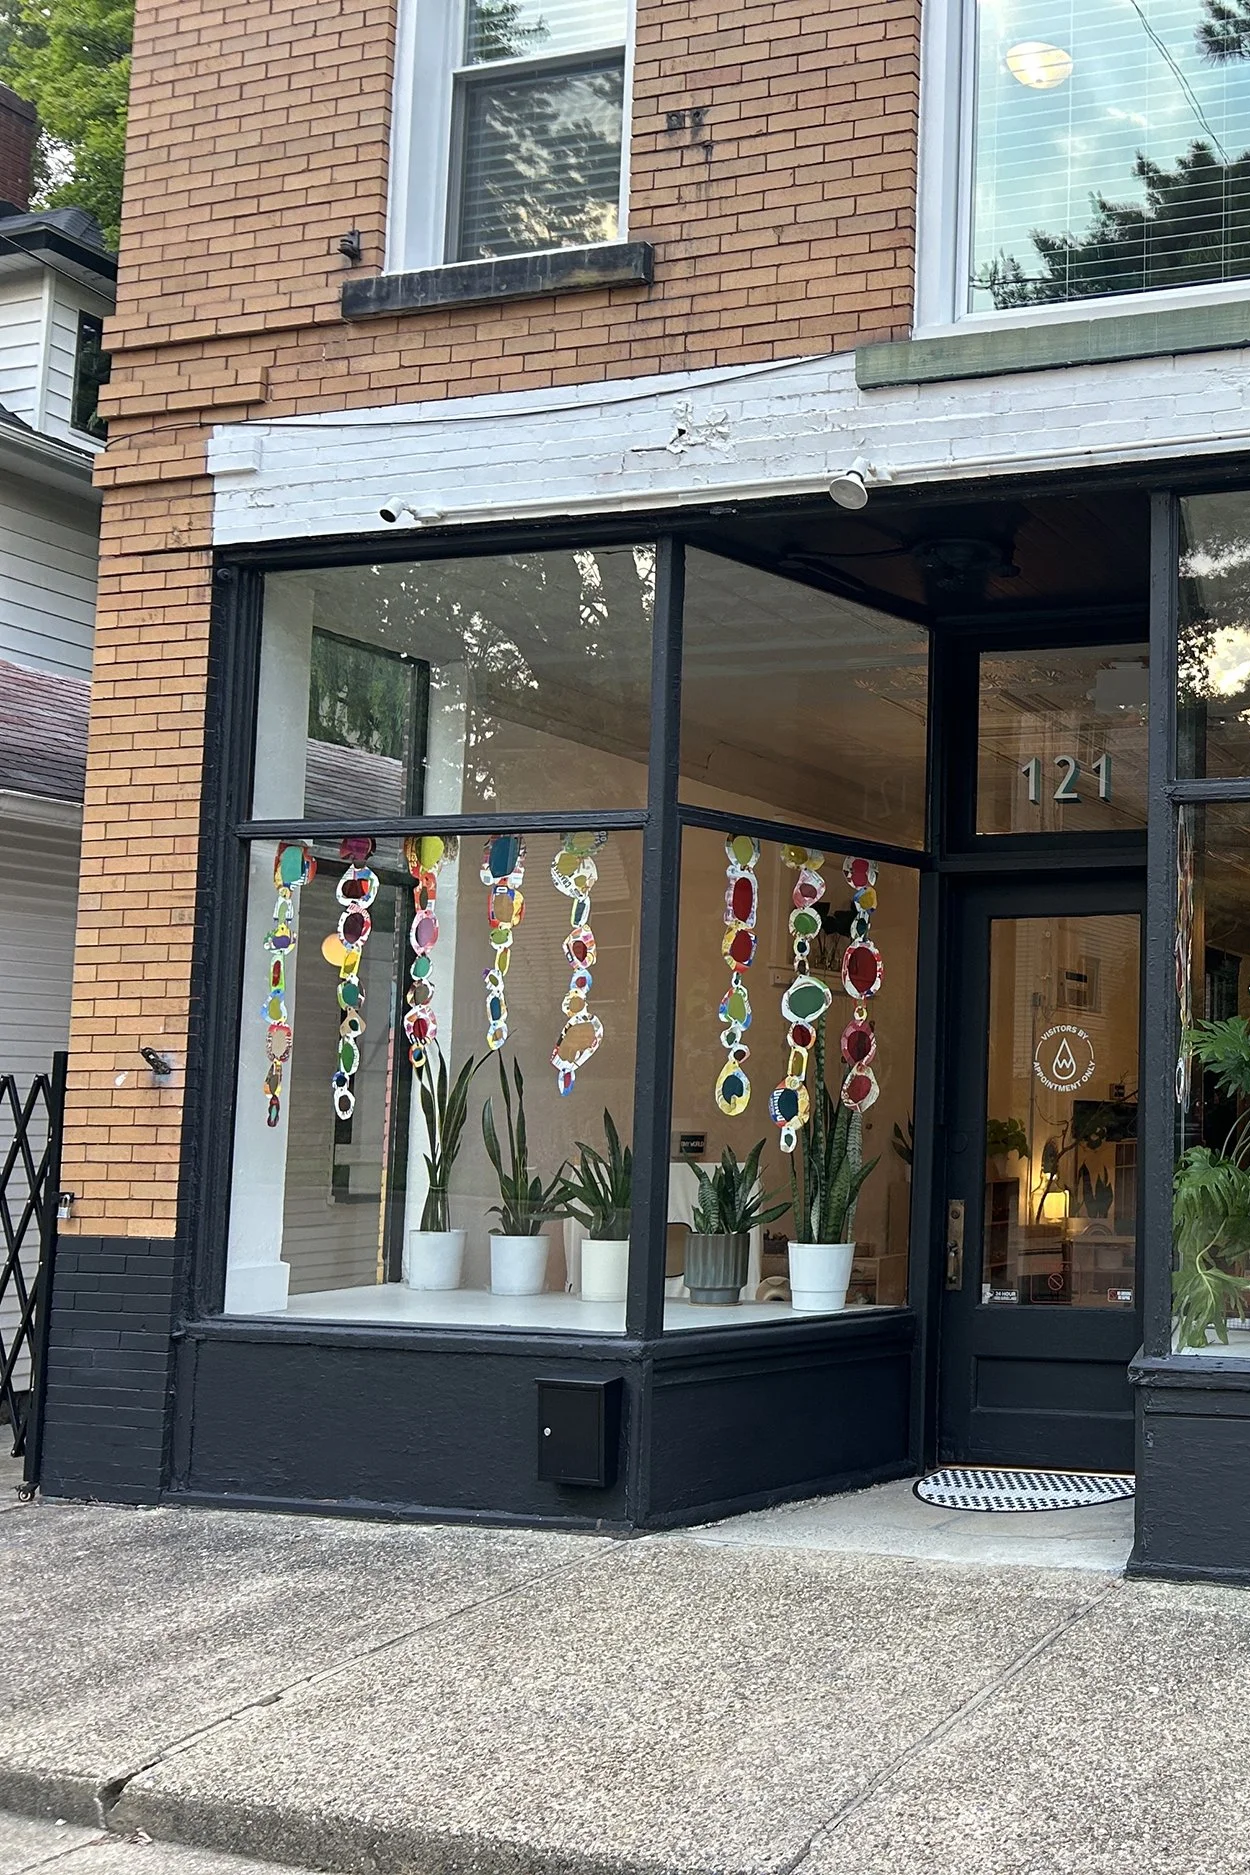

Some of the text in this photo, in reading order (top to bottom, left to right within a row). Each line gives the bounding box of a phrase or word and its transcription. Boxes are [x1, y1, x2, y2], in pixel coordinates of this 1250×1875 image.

[1022, 754, 1111, 804] 121
[1041, 1025, 1089, 1040] VISITORS BY
[1033, 1060, 1096, 1092] APPOINTMENT ONLY
